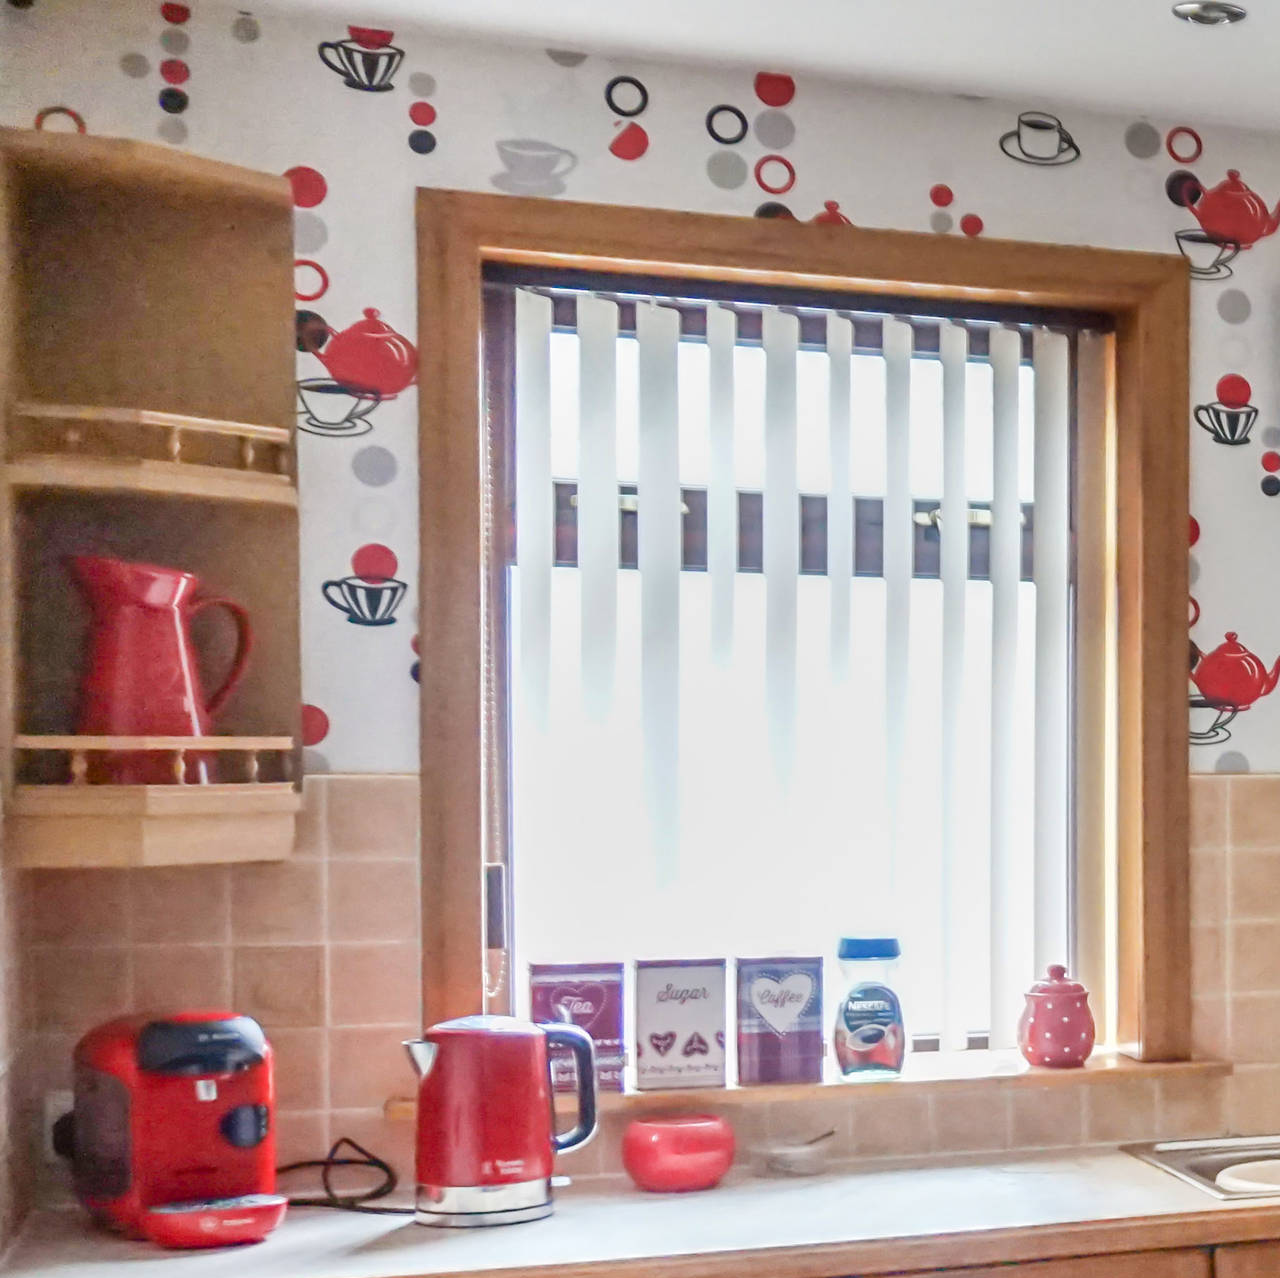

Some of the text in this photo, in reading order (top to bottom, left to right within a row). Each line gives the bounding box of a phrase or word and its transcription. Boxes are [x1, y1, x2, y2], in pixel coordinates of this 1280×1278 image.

[656, 983, 710, 1005] Sugar
[757, 989, 804, 1008] Coffee
[560, 995, 595, 1014] Tea
